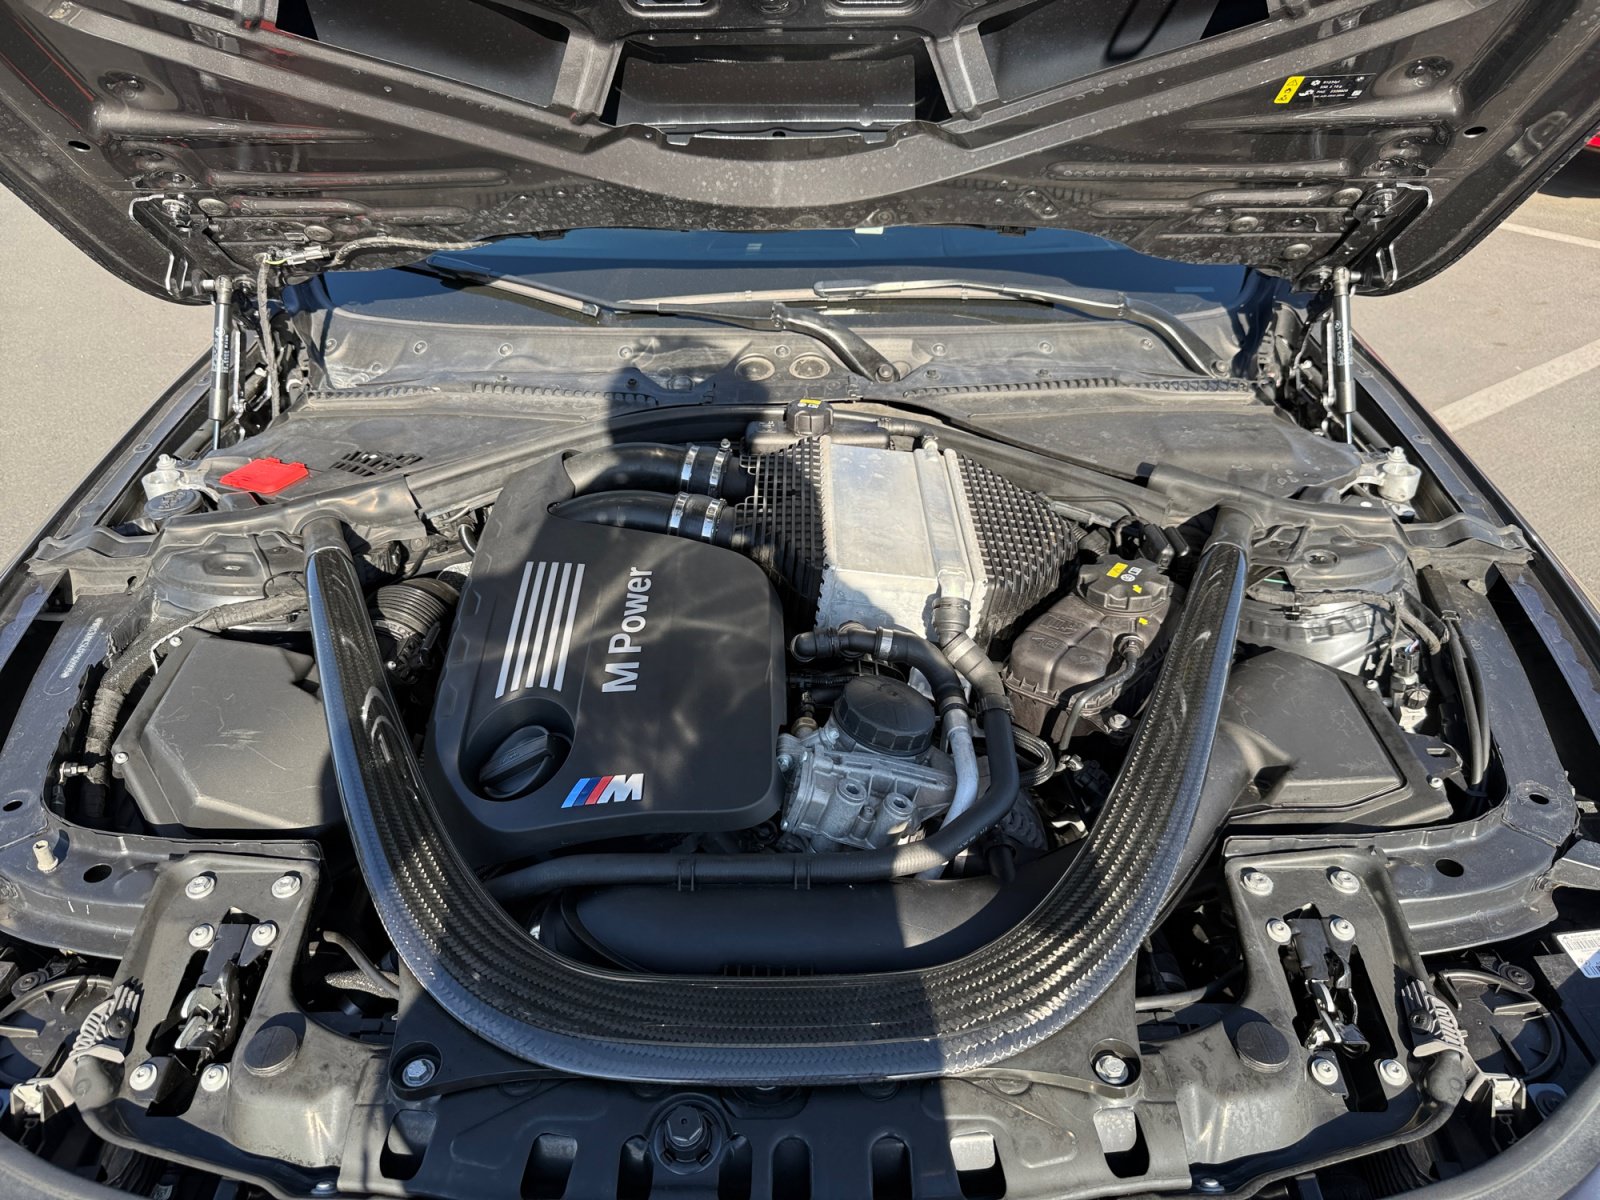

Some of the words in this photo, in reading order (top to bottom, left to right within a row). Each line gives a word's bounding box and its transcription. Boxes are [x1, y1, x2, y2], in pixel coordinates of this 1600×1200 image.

[608, 566, 652, 654] Power
[602, 661, 640, 693] M
[596, 773, 644, 805] M
